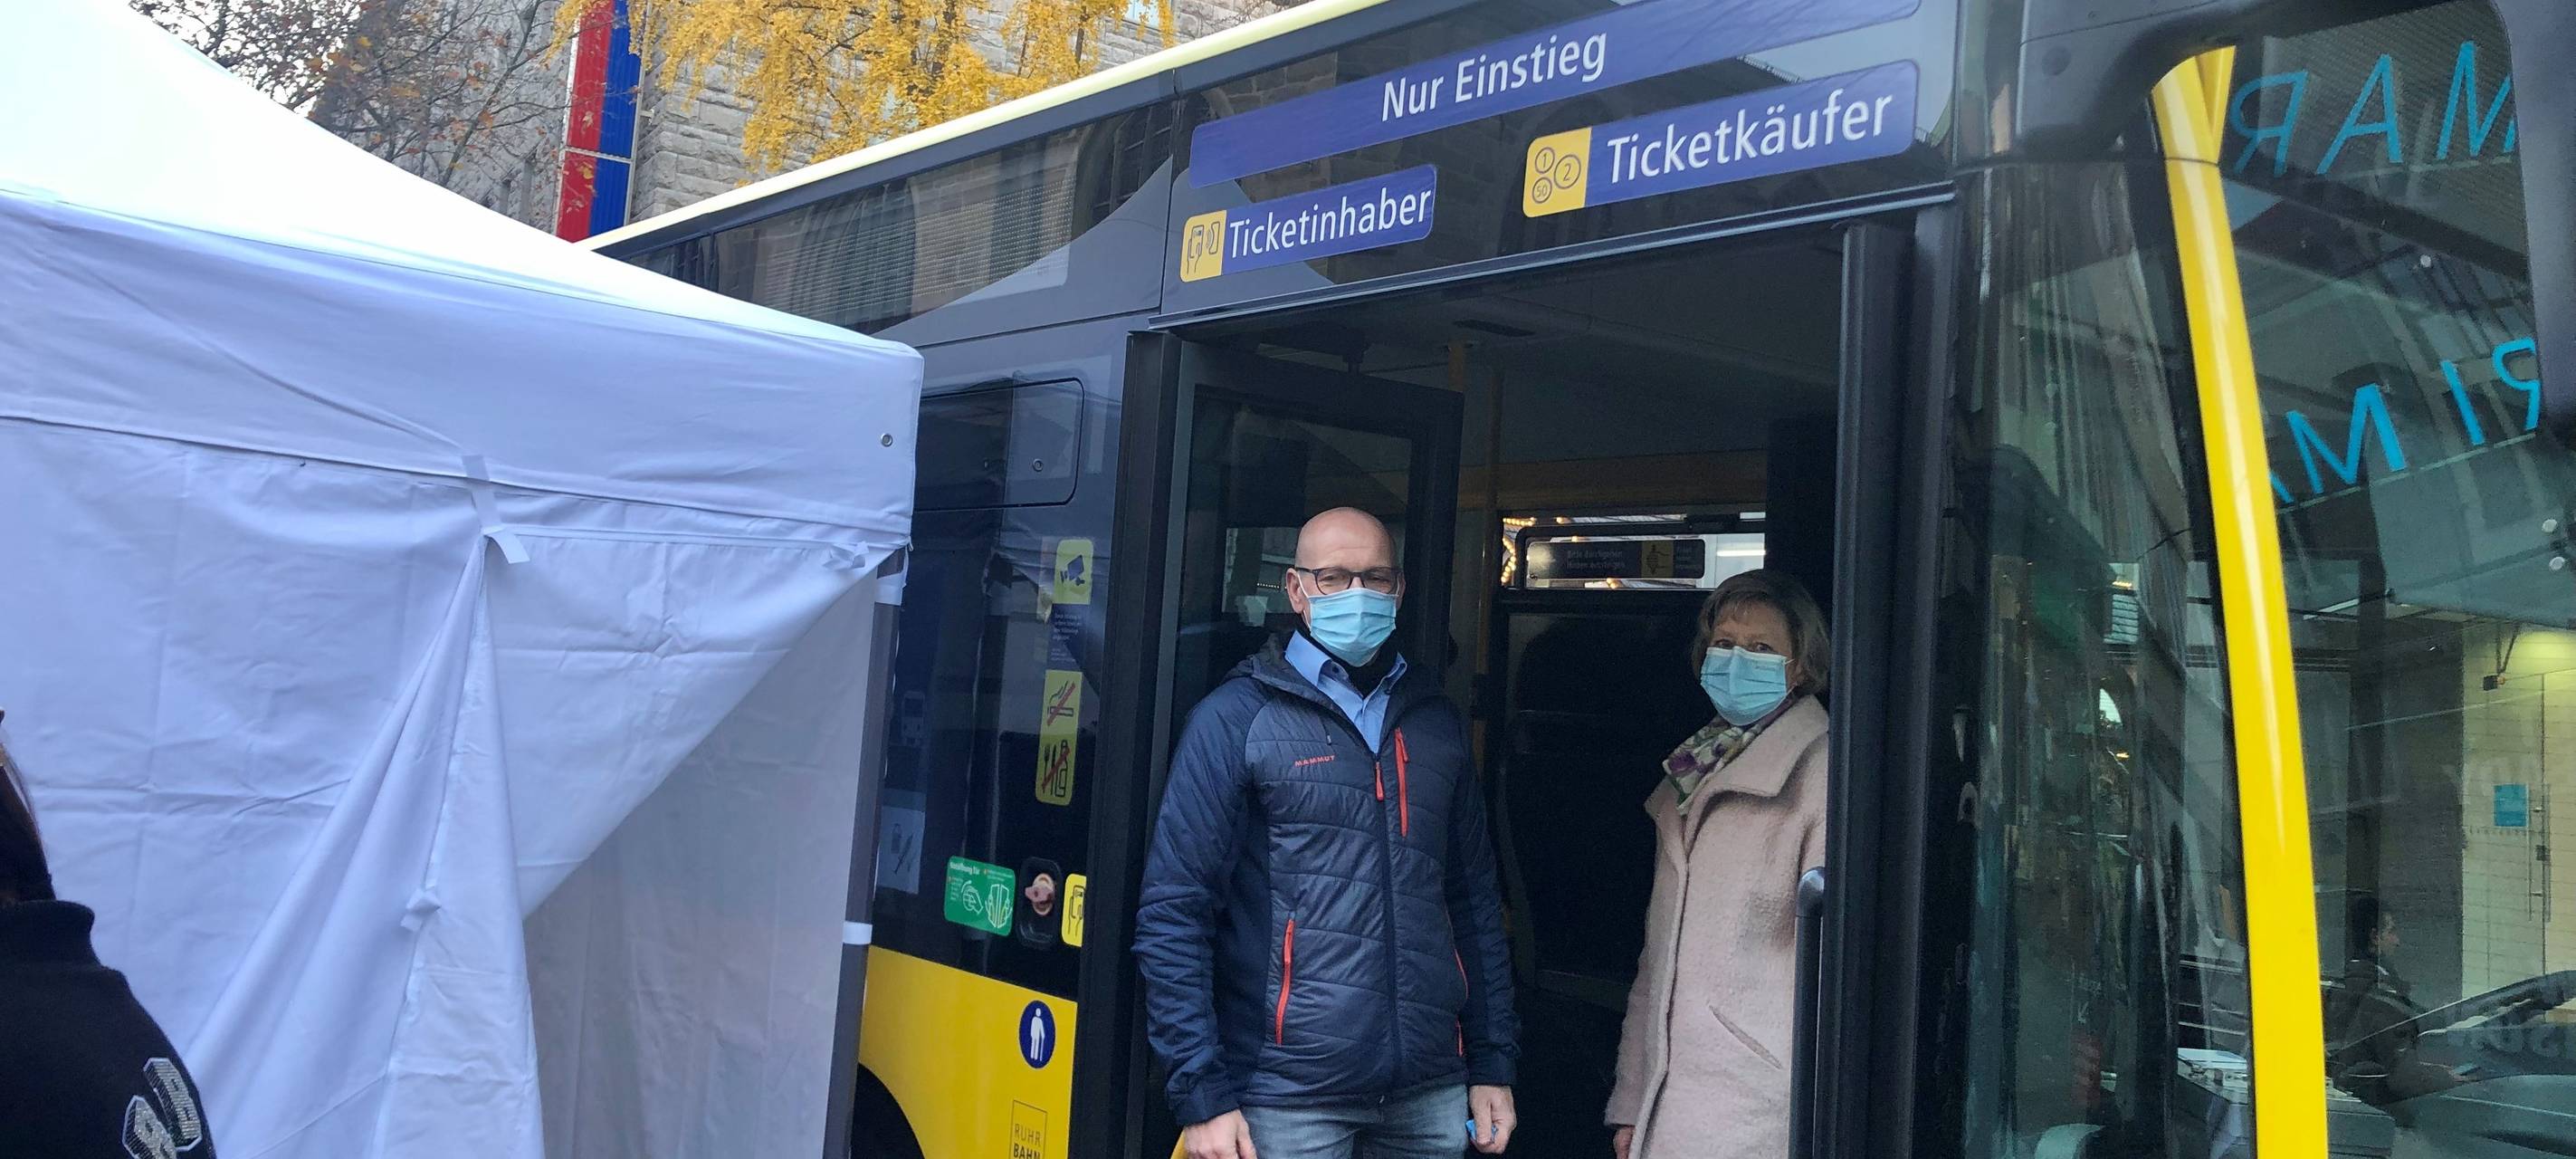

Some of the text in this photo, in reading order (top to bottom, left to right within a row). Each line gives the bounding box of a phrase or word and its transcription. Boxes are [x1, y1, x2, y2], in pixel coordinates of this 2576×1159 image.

[1381, 33, 1608, 123] Nur Einstieg
[1607, 88, 1894, 186] Ticketkäufer
[1563, 163, 1571, 181] 2
[1229, 187, 1432, 259] Ticketinhaber
[1294, 755, 1335, 767] MAMMUT
[1014, 1123, 1041, 1147] RUHR
[1013, 1143, 1040, 1159] BAHN
